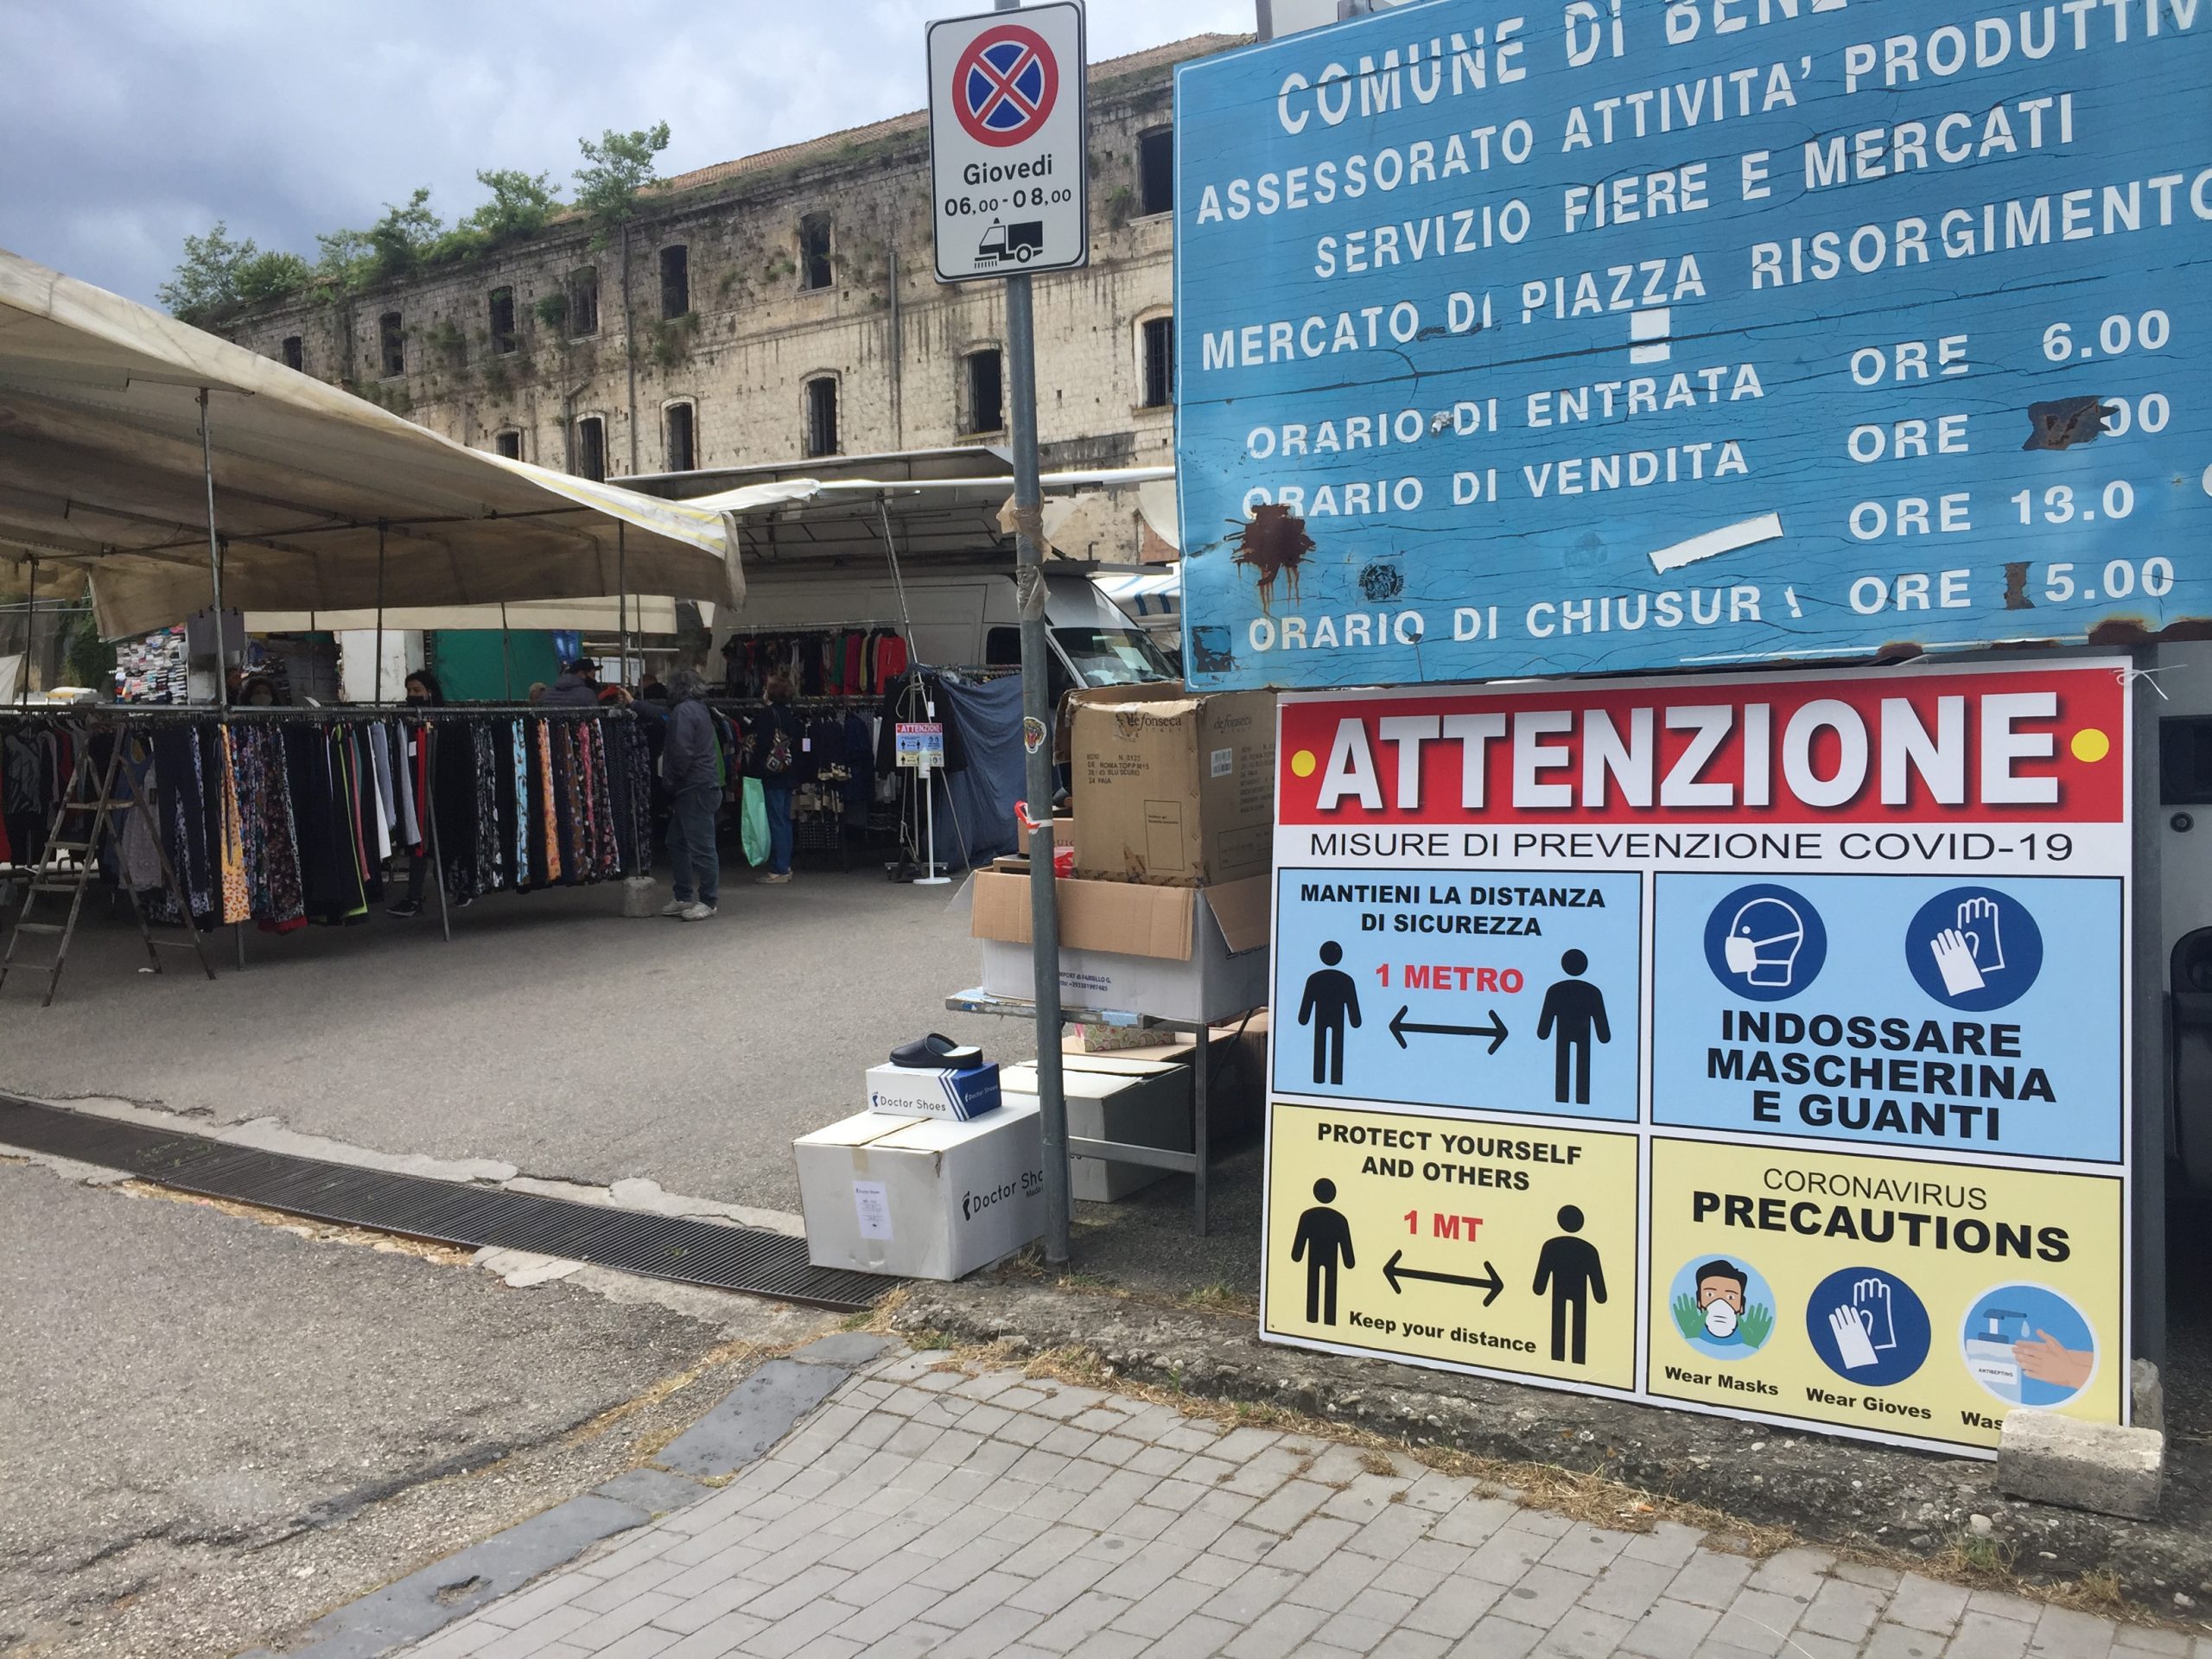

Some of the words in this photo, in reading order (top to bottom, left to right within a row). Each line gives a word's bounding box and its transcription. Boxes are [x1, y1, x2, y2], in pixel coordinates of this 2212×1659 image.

[1278, 16, 1528, 135] COMUNE
[1565, 0, 1624, 67] DI
[1197, 118, 1533, 225] ASSESSORATO
[1845, 0, 2212, 93] PRODUTTIV
[1314, 199, 1531, 278] SERVIZIO
[1565, 163, 1709, 233] FIERE
[1742, 150, 1771, 201] E
[1804, 93, 2073, 189] MERCATI
[1202, 301, 1420, 371] MERCATO
[1447, 291, 1492, 334] DI
[1521, 254, 1707, 325] PIAZZA
[1751, 168, 2212, 289] RISORGIMENTO
[1247, 410, 1424, 459] ORARIO
[1453, 398, 1497, 435] DI
[1527, 364, 1764, 428] ENTRATA
[1851, 334, 1968, 386] ORE
[2043, 309, 2171, 361] 6.00
[1243, 477, 1424, 521] ORARIO
[1452, 469, 1497, 505] DI
[1523, 441, 1749, 499] VENDITA
[1848, 414, 1969, 463] ORE
[1849, 493, 1971, 540] ORE
[2012, 480, 2134, 525] 13.0
[1249, 610, 1425, 651] ORARIO
[1454, 607, 1497, 640] DI
[1849, 569, 1971, 614] ORE
[2044, 556, 2174, 602] 5.00
[1316, 691, 2059, 810] ATTENZIONE
[1310, 832, 1451, 857] MISURE
[1464, 833, 1498, 858] DI
[1514, 833, 1822, 859] PREVENZIONE
[1839, 832, 2074, 861] COVID-19
[1300, 884, 1421, 905] MANTIENI
[1429, 887, 1461, 906] LA
[1470, 887, 1606, 908] DISTANZA
[1361, 913, 1384, 931] DI
[1394, 914, 1542, 937] SICUREZZA
[1375, 963, 1389, 988] 1
[1404, 965, 1524, 994] METRO
[1721, 1010, 2022, 1058] INDOSSARE
[1707, 1048, 2057, 1103] MASCHERINA
[880, 1096, 913, 1109] Doctor
[917, 1096, 947, 1112] Shoes
[1752, 1090, 1782, 1123] E
[1798, 1093, 2000, 1141] GUANTI
[1318, 1122, 1433, 1151] PROTECT
[1440, 1134, 1583, 1166] YOURSELF
[1361, 1155, 1414, 1179] AND
[1422, 1161, 1530, 1191] OTHERS
[1763, 1166, 1988, 1211] CORONAVIRUS
[973, 1182, 1017, 1213] Doctor
[1403, 1210, 1419, 1235] 1
[1433, 1213, 1484, 1243] MT
[1692, 1191, 2072, 1263] PRECAUTIONS
[1349, 1310, 1397, 1337] Keep
[1402, 1321, 1444, 1344] your
[1450, 1325, 1537, 1353] distance
[1664, 1365, 1713, 1389] Wear
[1716, 1374, 1780, 1397] Masks
[1805, 1387, 1858, 1408] Wear
